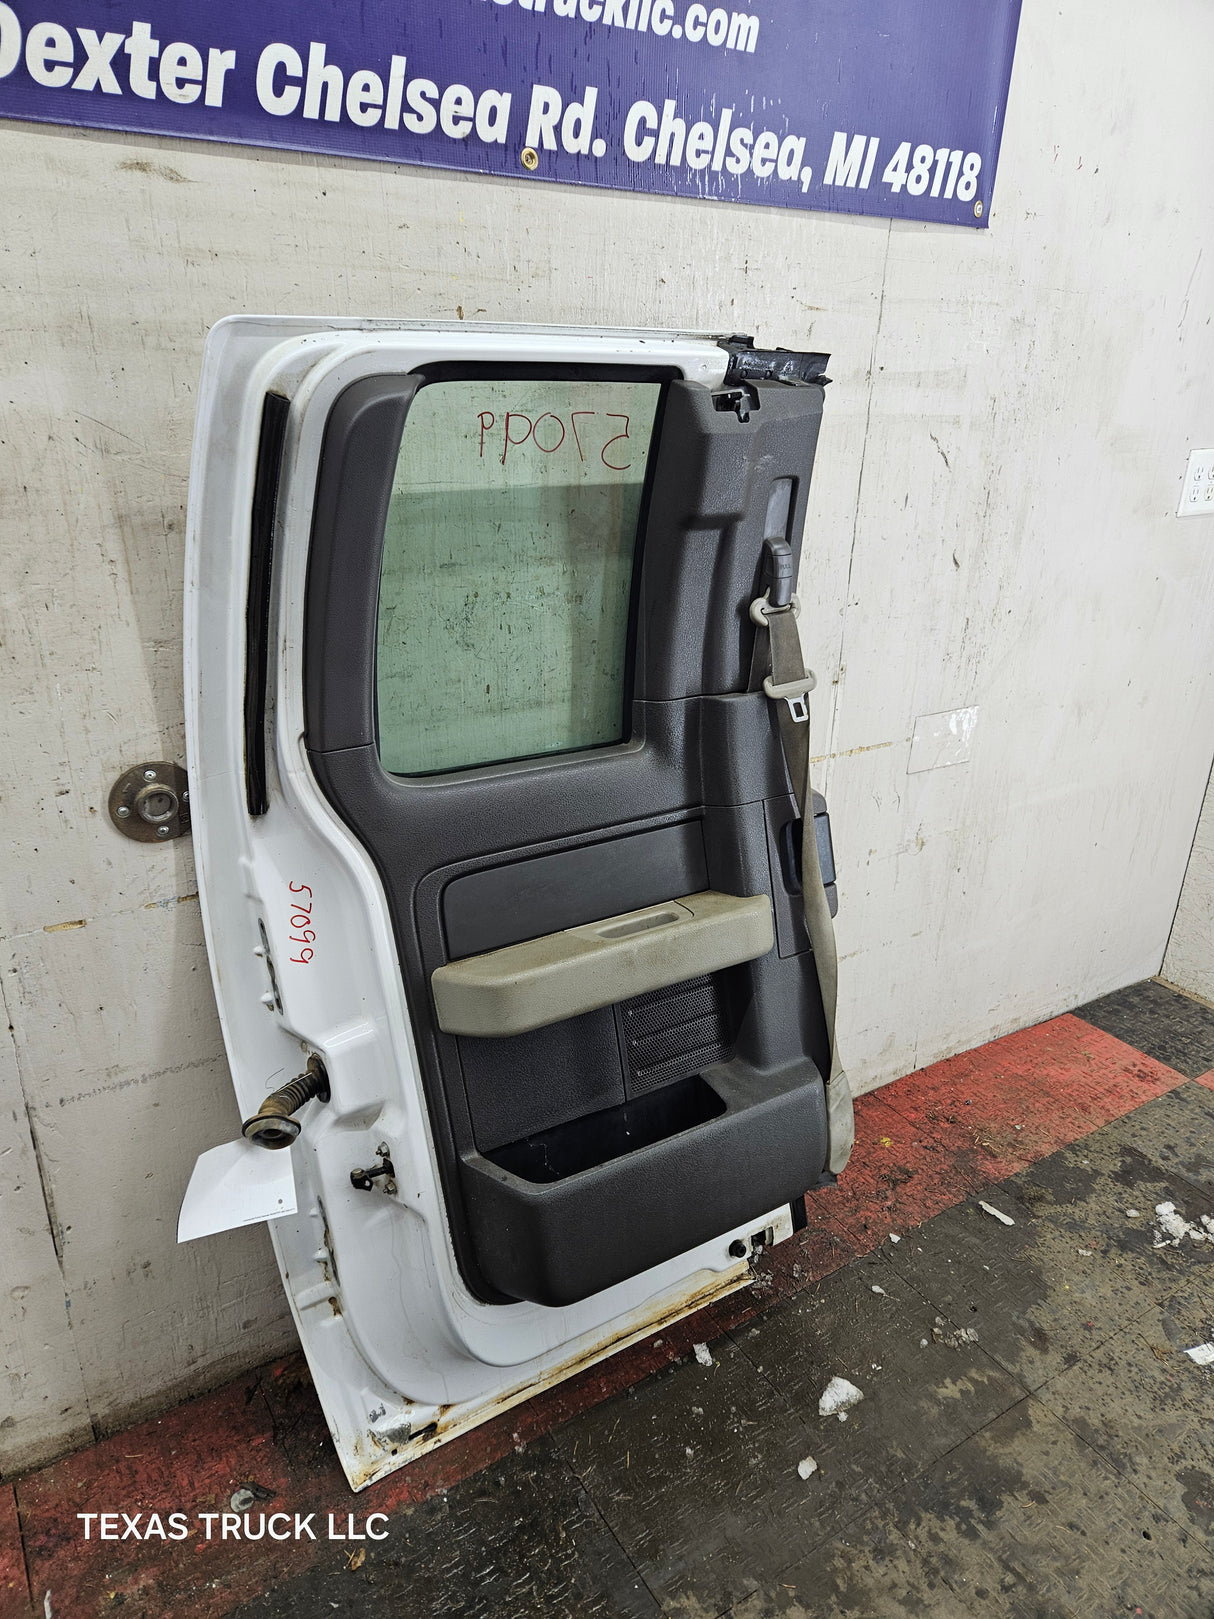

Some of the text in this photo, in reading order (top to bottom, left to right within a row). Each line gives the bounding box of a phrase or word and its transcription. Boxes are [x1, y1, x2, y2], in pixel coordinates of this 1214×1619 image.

[256, 42, 512, 144] Chelsea
[525, 84, 607, 157] Rd.
[623, 99, 822, 193] Chelsea,
[823, 131, 880, 190] MI
[882, 142, 982, 202] 48118
[288, 880, 316, 964] 57099
